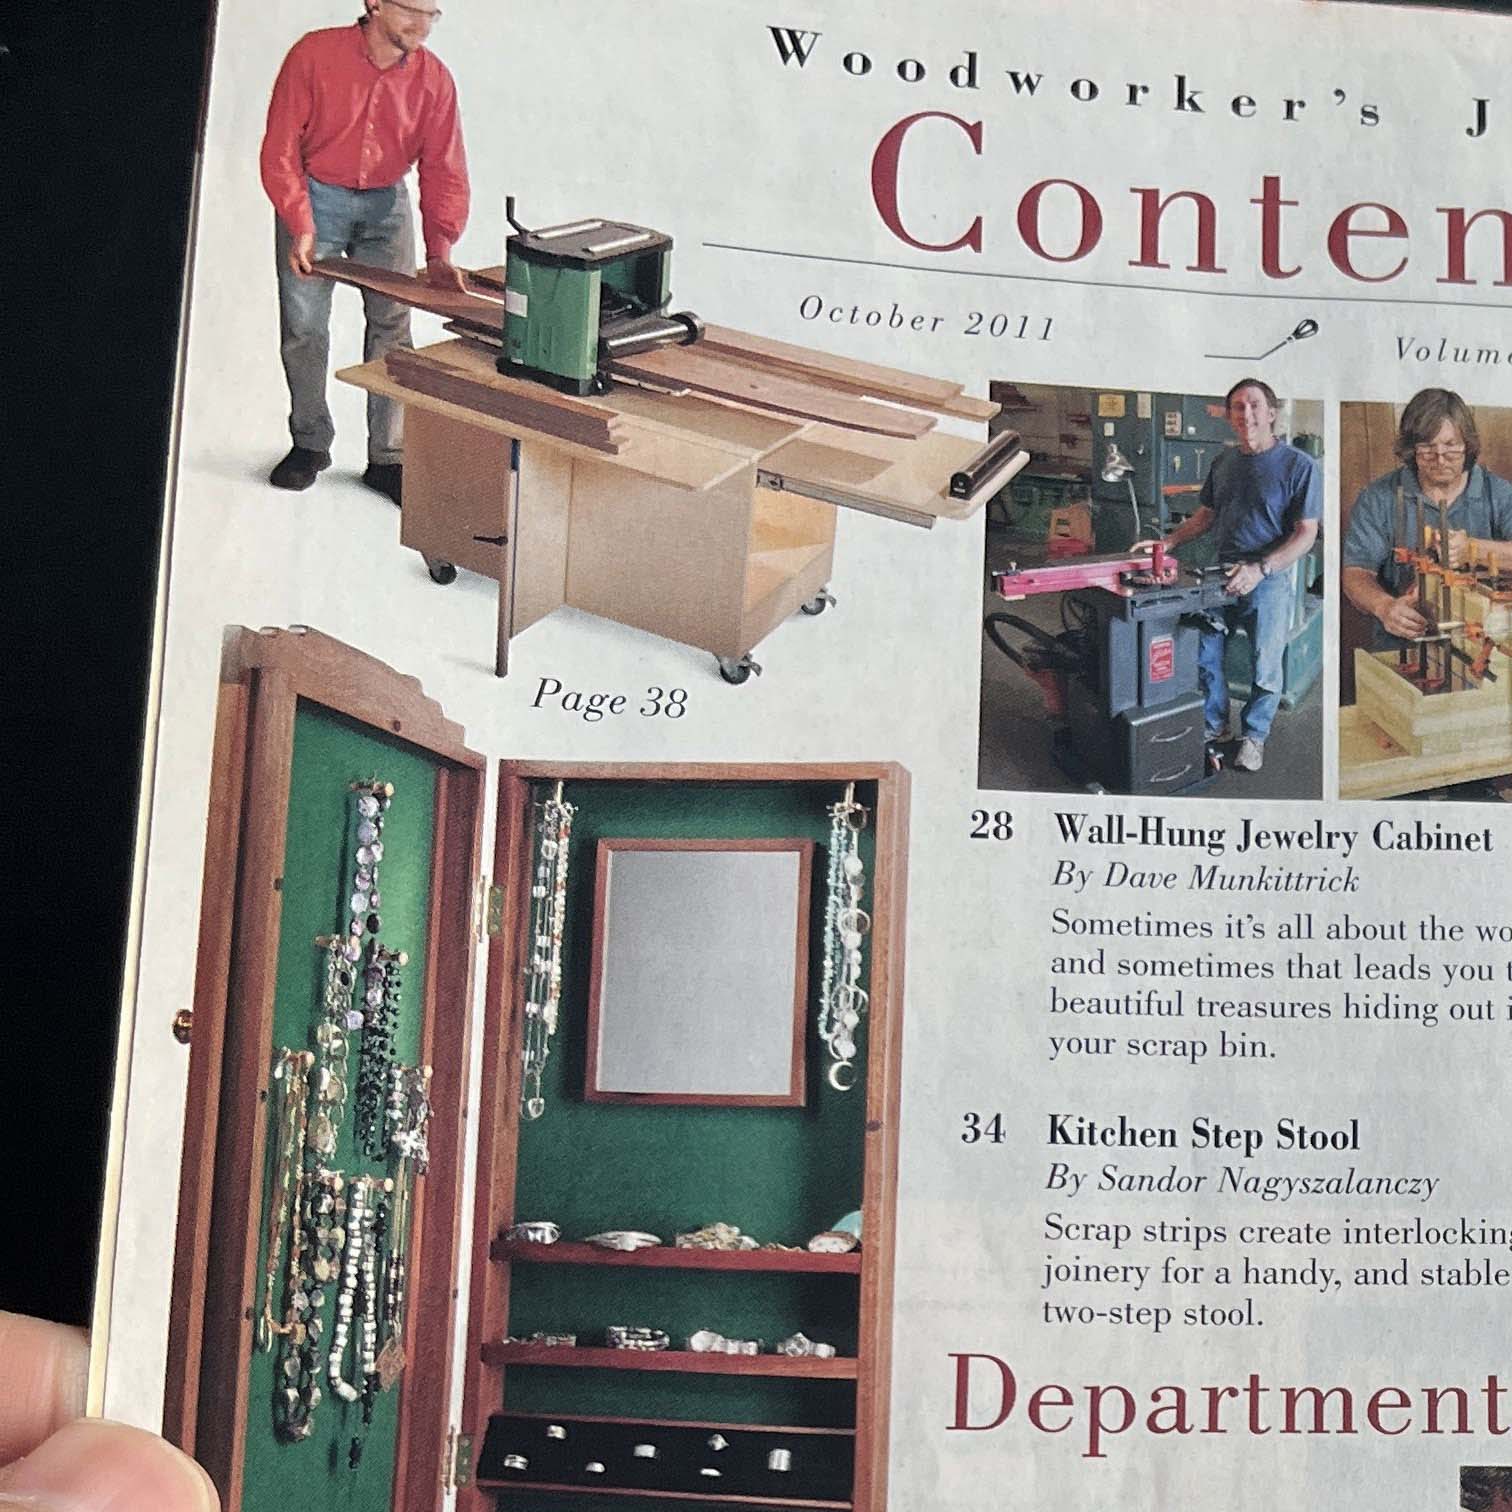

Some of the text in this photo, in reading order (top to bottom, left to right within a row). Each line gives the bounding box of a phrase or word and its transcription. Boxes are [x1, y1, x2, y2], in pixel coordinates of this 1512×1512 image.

[765, 24, 1381, 129] Woodworker's
[799, 294, 1053, 341] October 2011
[530, 677, 688, 723] Page 38
[969, 809, 1494, 859] 28 Wall-Hung Jewelry Cabinet
[1051, 907, 1213, 939] Sometimes
[1225, 913, 1266, 940] it's
[1277, 913, 1314, 940] all
[1326, 913, 1407, 941] about
[1419, 914, 1464, 942] the
[961, 1111, 1361, 1159] 34 Kitchen Step Stool
